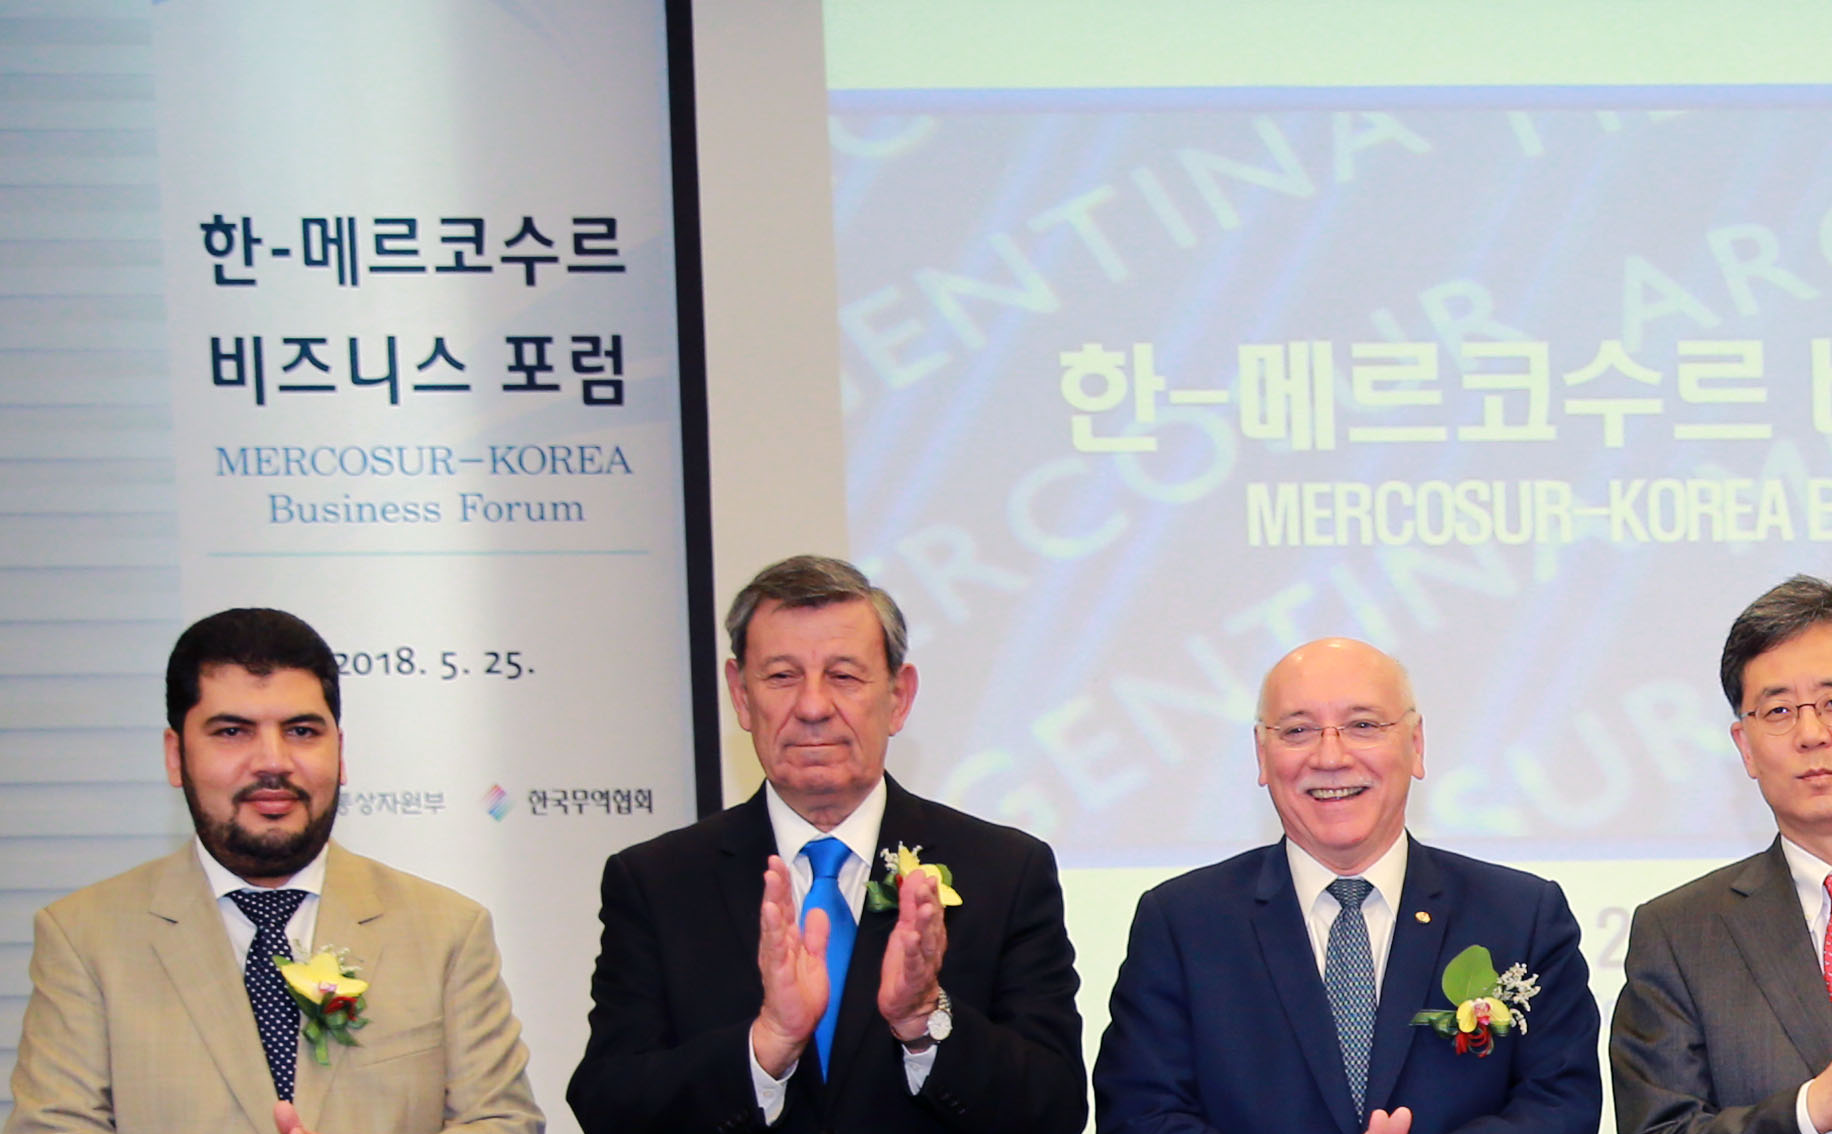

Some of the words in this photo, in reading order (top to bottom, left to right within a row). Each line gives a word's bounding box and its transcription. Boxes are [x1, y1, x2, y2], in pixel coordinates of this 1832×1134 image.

[200, 213, 627, 287] 한-메르코수르
[210, 335, 471, 406] 비즈니스
[502, 335, 625, 407] 포럼
[1059, 339, 1773, 453] 한-메르코수르
[216, 444, 633, 477] MERCOSUR-KOREA
[268, 493, 442, 525] Business
[460, 493, 585, 523] Forum
[1246, 476, 1796, 547] MERCOSUR-KOREA
[335, 646, 427, 676] 2018.
[441, 651, 470, 681] 5.
[484, 651, 536, 680] 25.
[528, 788, 654, 816] 한국무역협회
